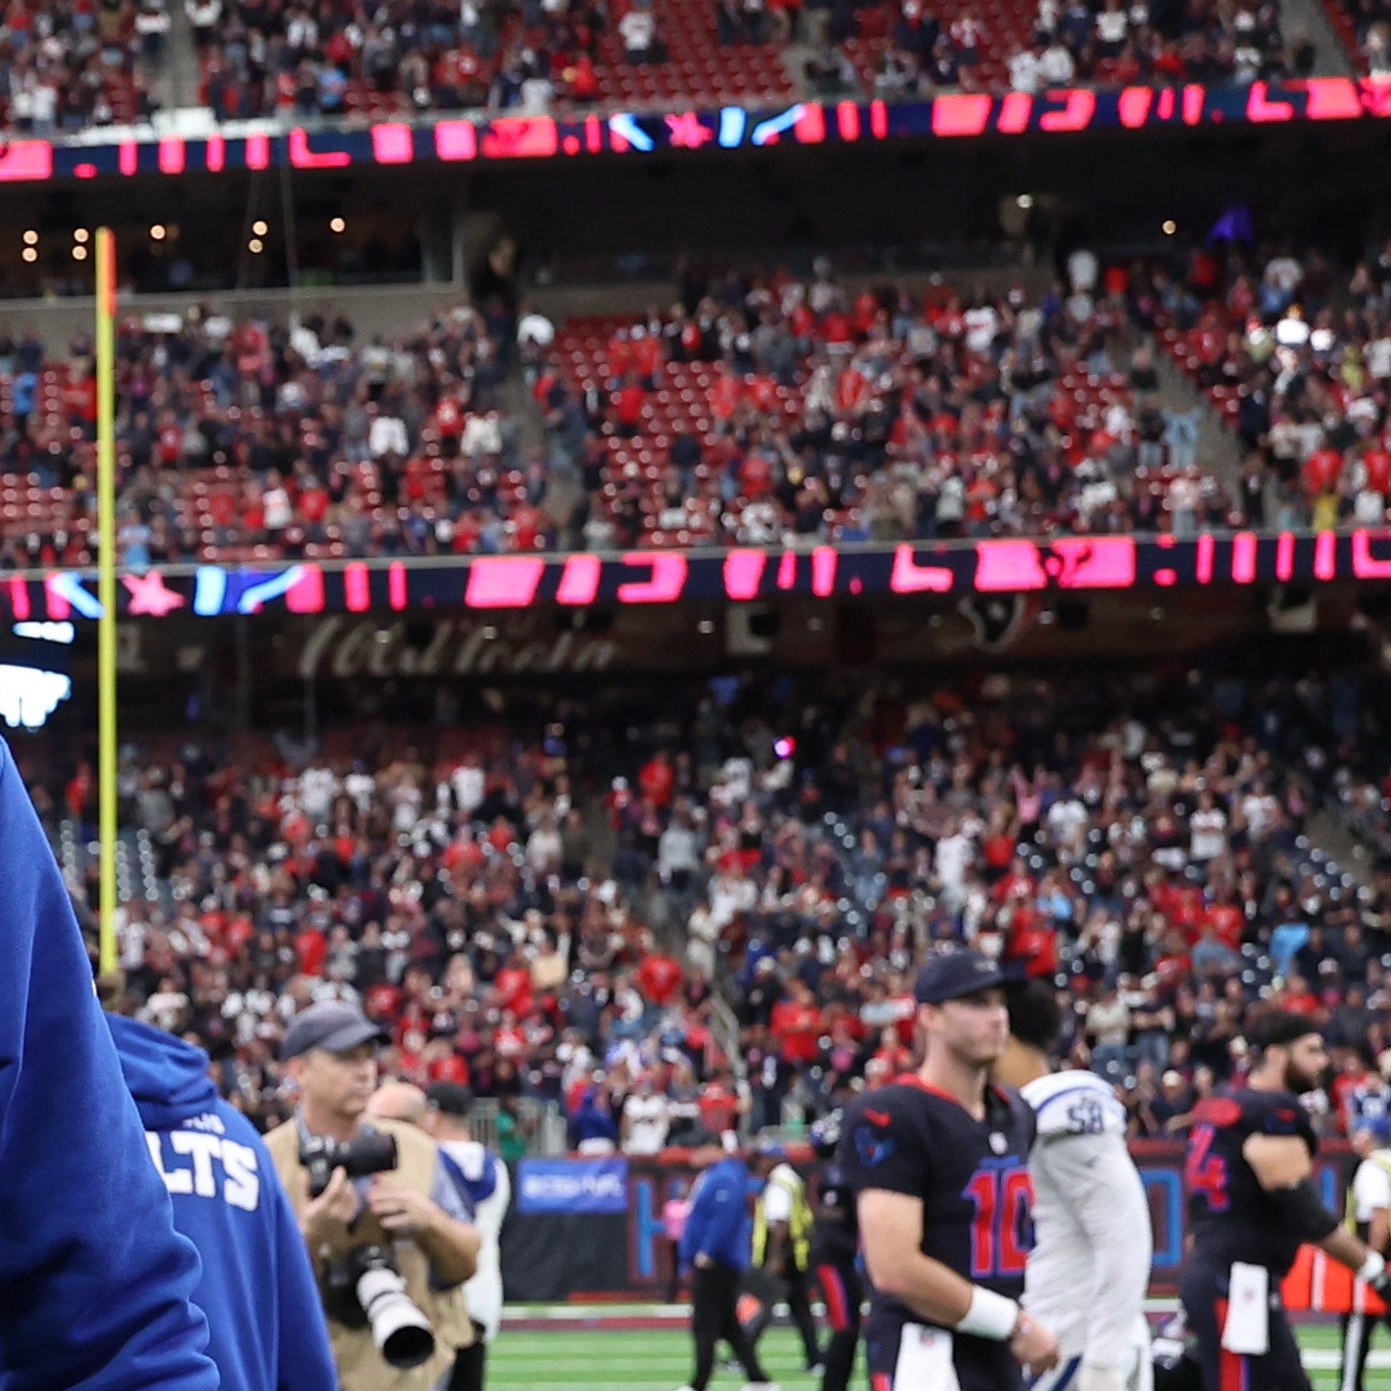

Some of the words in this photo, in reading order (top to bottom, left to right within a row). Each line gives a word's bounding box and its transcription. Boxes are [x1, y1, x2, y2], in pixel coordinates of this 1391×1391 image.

[1067, 1101, 1104, 1134] 58
[145, 1131, 259, 1212] LTS
[962, 1166, 1036, 1278] 10
